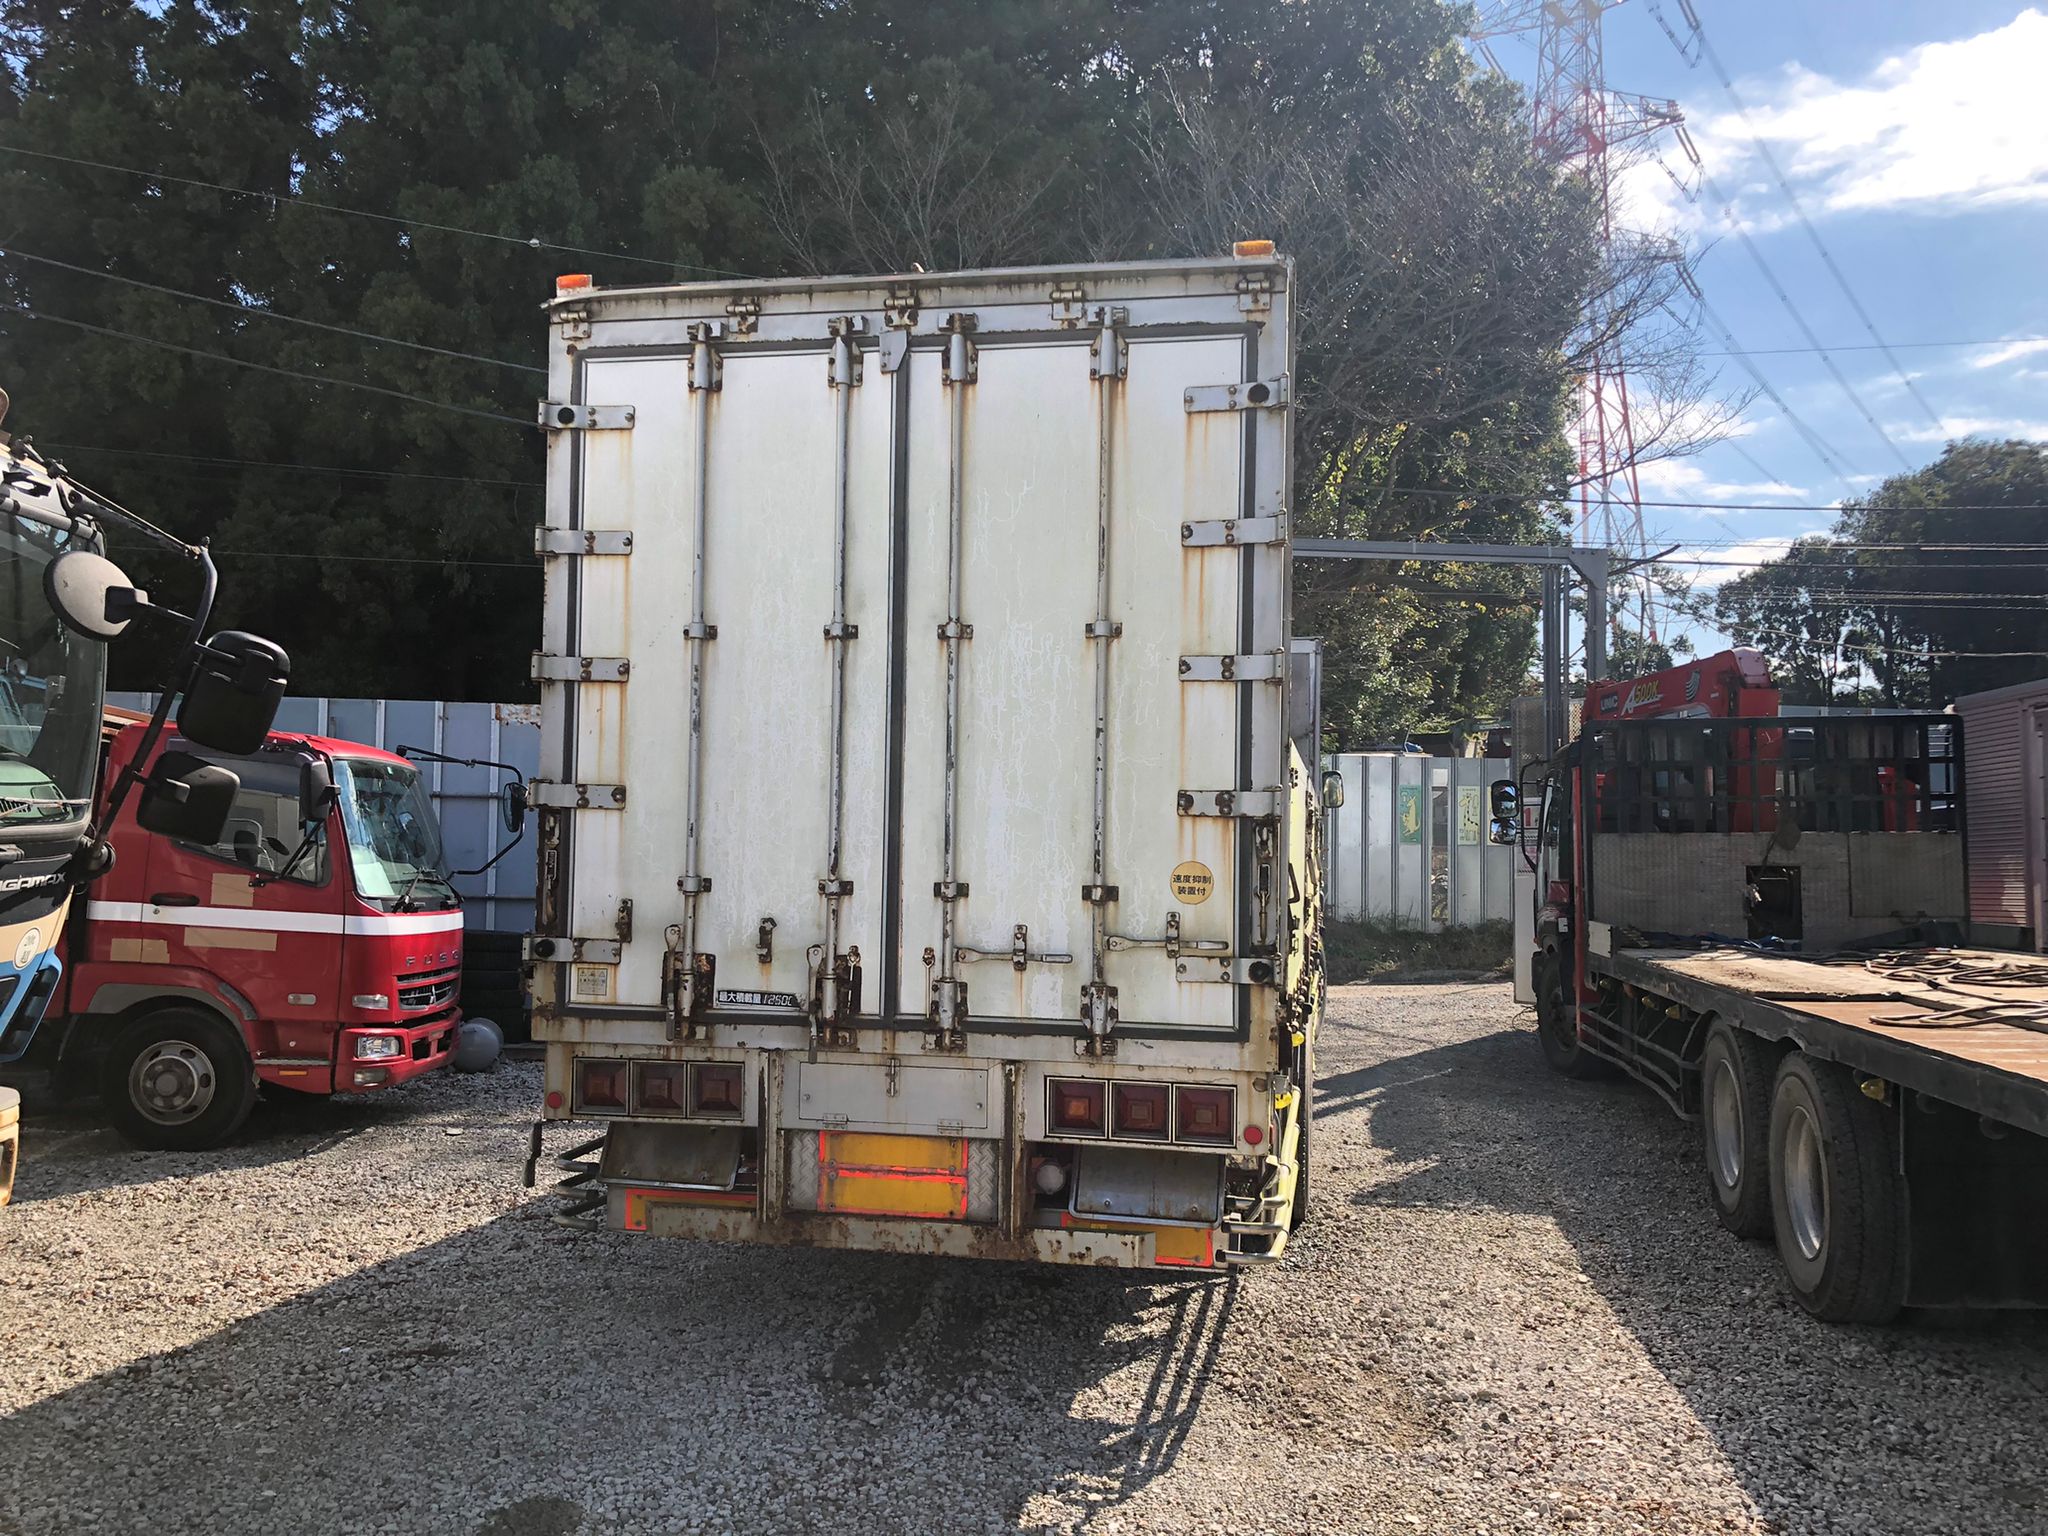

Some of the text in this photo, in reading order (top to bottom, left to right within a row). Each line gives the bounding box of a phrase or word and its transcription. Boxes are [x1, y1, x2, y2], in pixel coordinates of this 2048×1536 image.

[1172, 874, 1211, 884] 速度抑制
[1178, 886, 1206, 896] 装置付
[405, 949, 460, 967] FUSO
[719, 991, 761, 1004] 最大積載量
